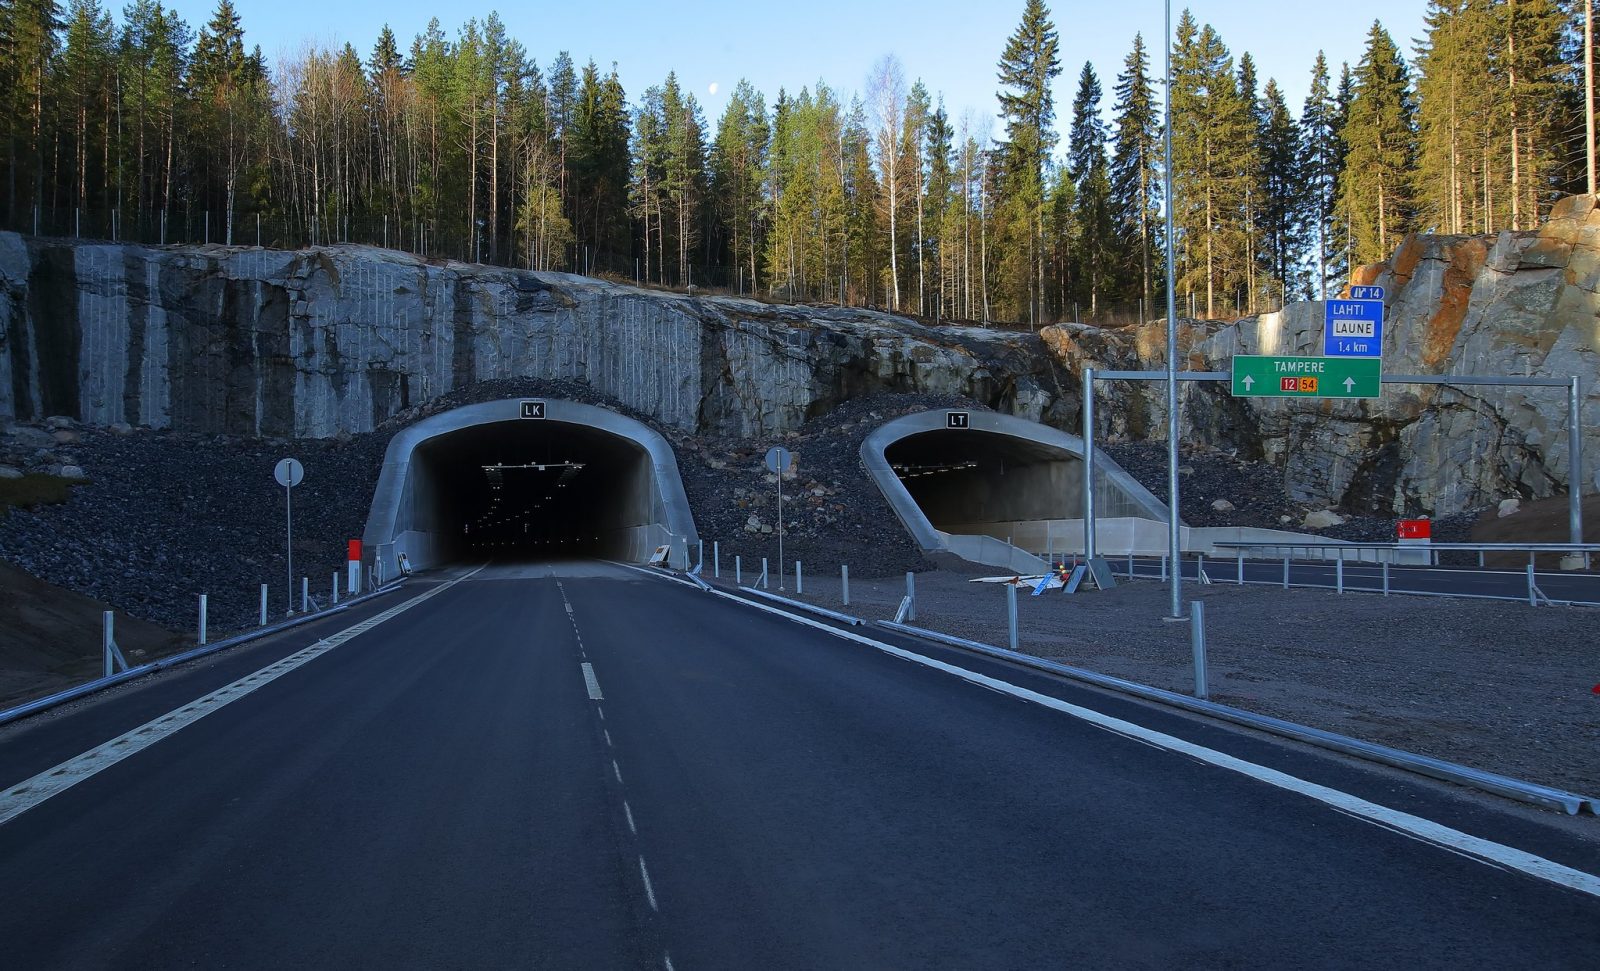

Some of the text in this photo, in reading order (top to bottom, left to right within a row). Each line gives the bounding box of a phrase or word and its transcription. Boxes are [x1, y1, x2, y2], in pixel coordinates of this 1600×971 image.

[1370, 288, 1379, 298] 14
[1334, 304, 1364, 315] LAHTI
[1336, 323, 1372, 334] LAUNE
[1354, 342, 1368, 352] km
[1274, 362, 1324, 372] TAMPERE
[1284, 379, 1314, 390] 12 54
[526, 405, 540, 416] LK
[952, 416, 964, 425] LT
